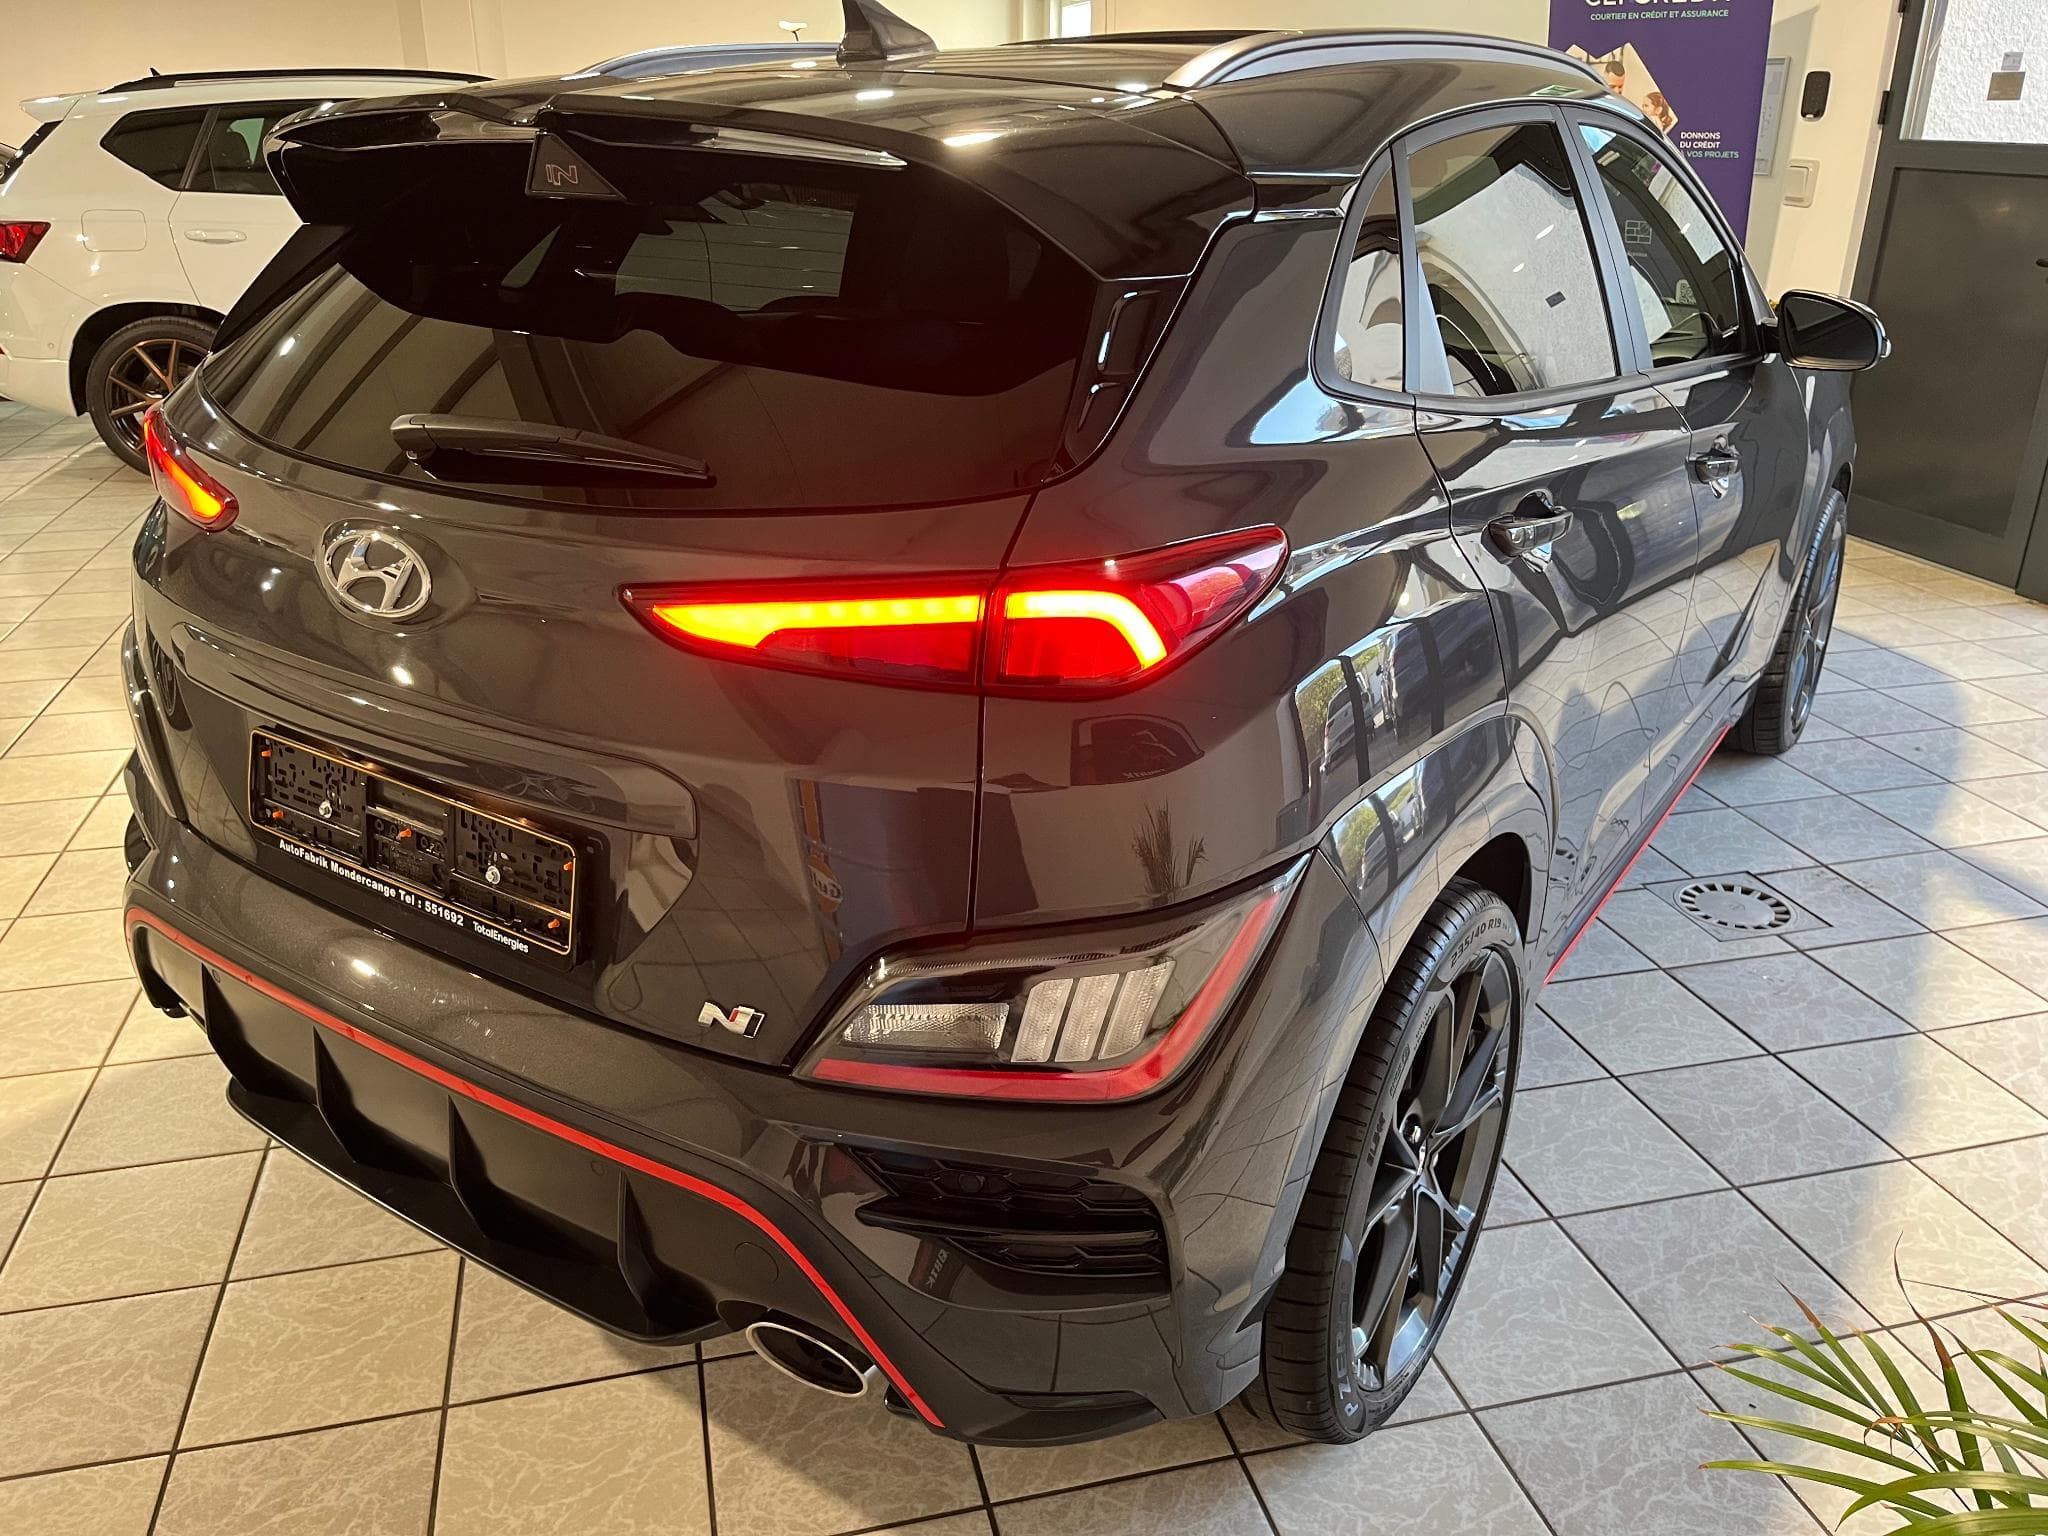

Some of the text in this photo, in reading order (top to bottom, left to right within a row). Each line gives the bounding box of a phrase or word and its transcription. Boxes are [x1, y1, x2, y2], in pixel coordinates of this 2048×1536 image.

[1590, 9, 1729, 21] COURTIER EN CRÉDIT ET ASSURANCE
[1680, 131, 1721, 140] DONNONS
[1680, 140, 1721, 149] DU CRÉDIT
[1687, 150, 1703, 158] VOS
[1704, 150, 1739, 159] PROJETS
[279, 839, 329, 869] AutoFabrik
[330, 860, 396, 898] Mondercange
[398, 889, 415, 906] Tel
[424, 900, 464, 927] 551692
[472, 920, 529, 953] TotalEnergies
